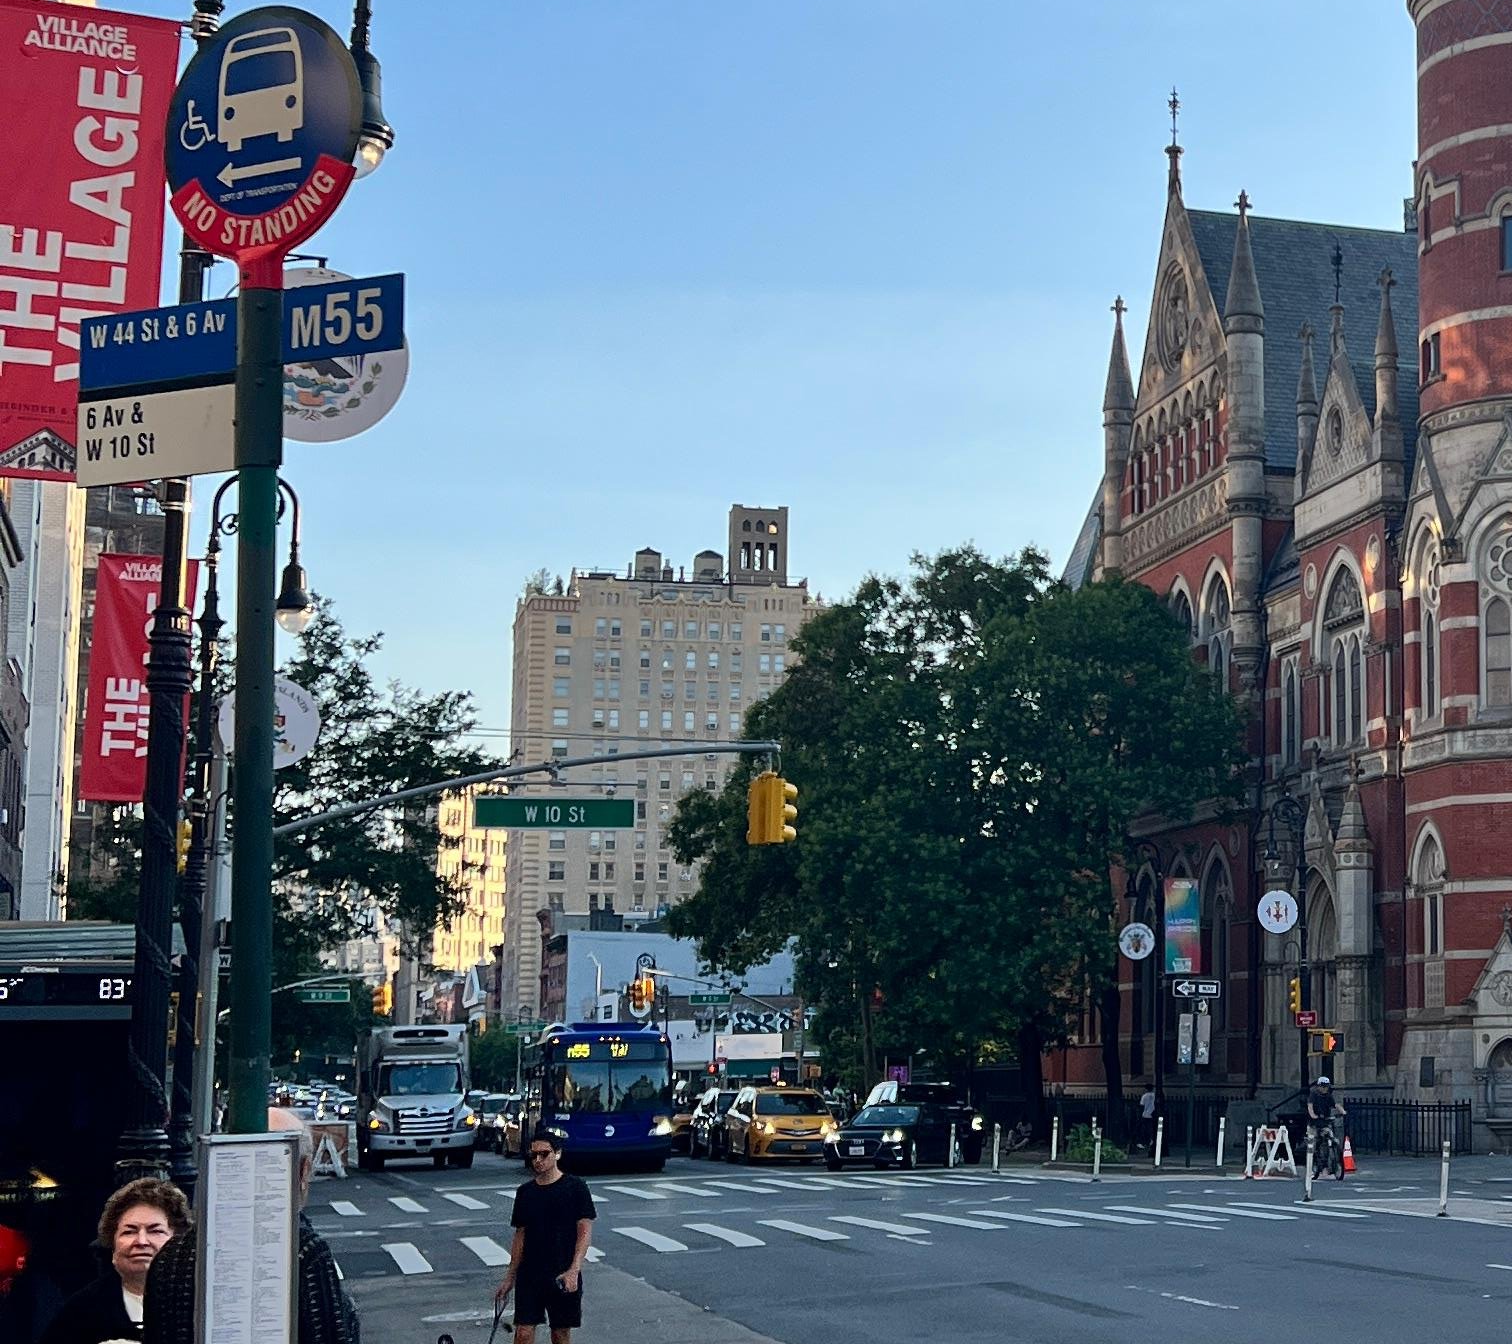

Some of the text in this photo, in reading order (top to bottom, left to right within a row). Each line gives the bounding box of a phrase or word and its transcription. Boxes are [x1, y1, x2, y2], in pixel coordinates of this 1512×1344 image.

[24, 30, 136, 61] ALLIANCE
[36, 14, 128, 44] VILLAGE
[183, 170, 336, 246] NO STANDING
[0, 224, 63, 377] THE
[291, 287, 384, 349] M55
[90, 310, 226, 349] W 44 St & 6 Av
[87, 406, 97, 430] 6
[103, 404, 124, 428] Av
[131, 401, 144, 424] &
[86, 432, 155, 462] W 10 St
[100, 677, 140, 757] THE
[524, 805, 585, 823] W 10 St
